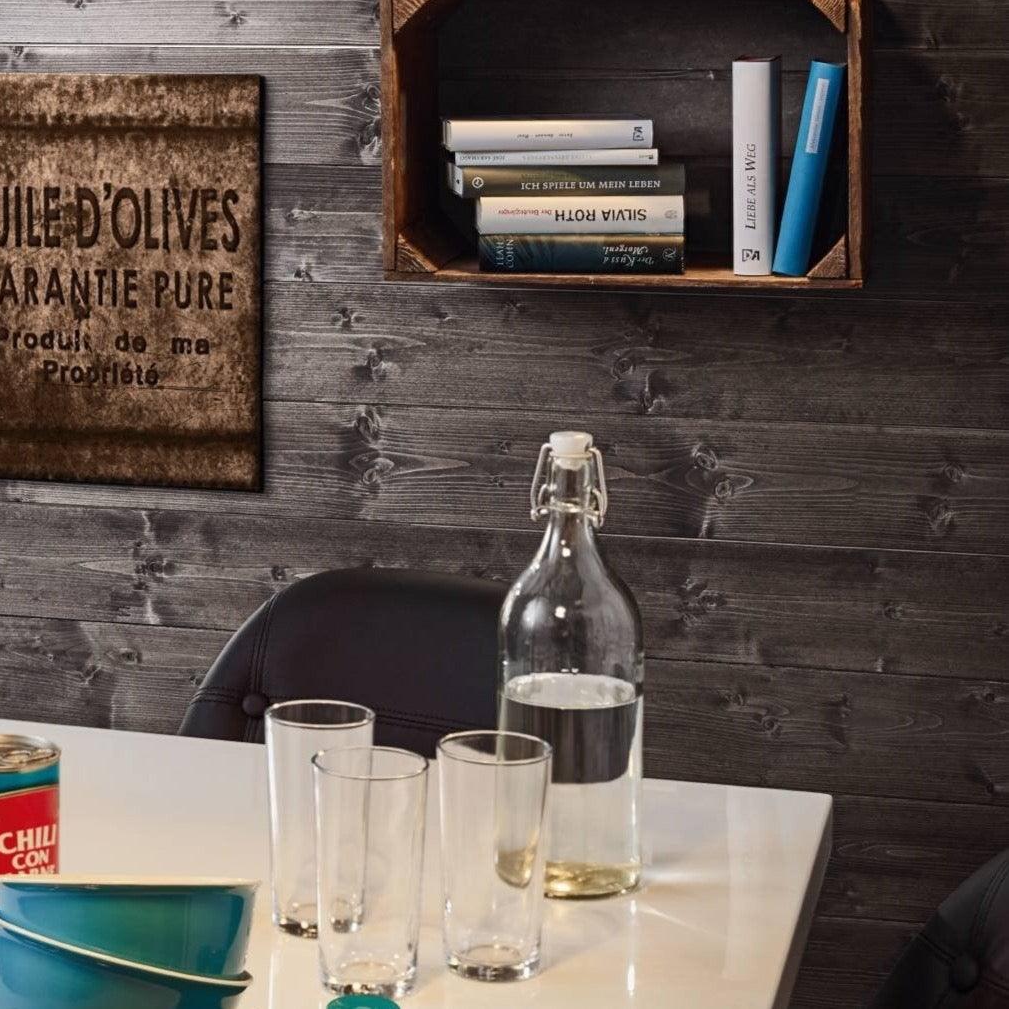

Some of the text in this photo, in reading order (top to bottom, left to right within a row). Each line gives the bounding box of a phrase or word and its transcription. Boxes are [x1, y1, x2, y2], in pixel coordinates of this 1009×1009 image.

[521, 180, 661, 190] ICH SPIELE UM MEIN LEBEN
[744, 143, 758, 230] LIEBE ALS WEG
[76, 183, 241, 253] D'OLIVES
[554, 208, 596, 222] ROTH
[154, 270, 234, 311] PURE
[115, 331, 147, 353] de
[171, 337, 210, 355] ma
[11, 848, 50, 870] CON
